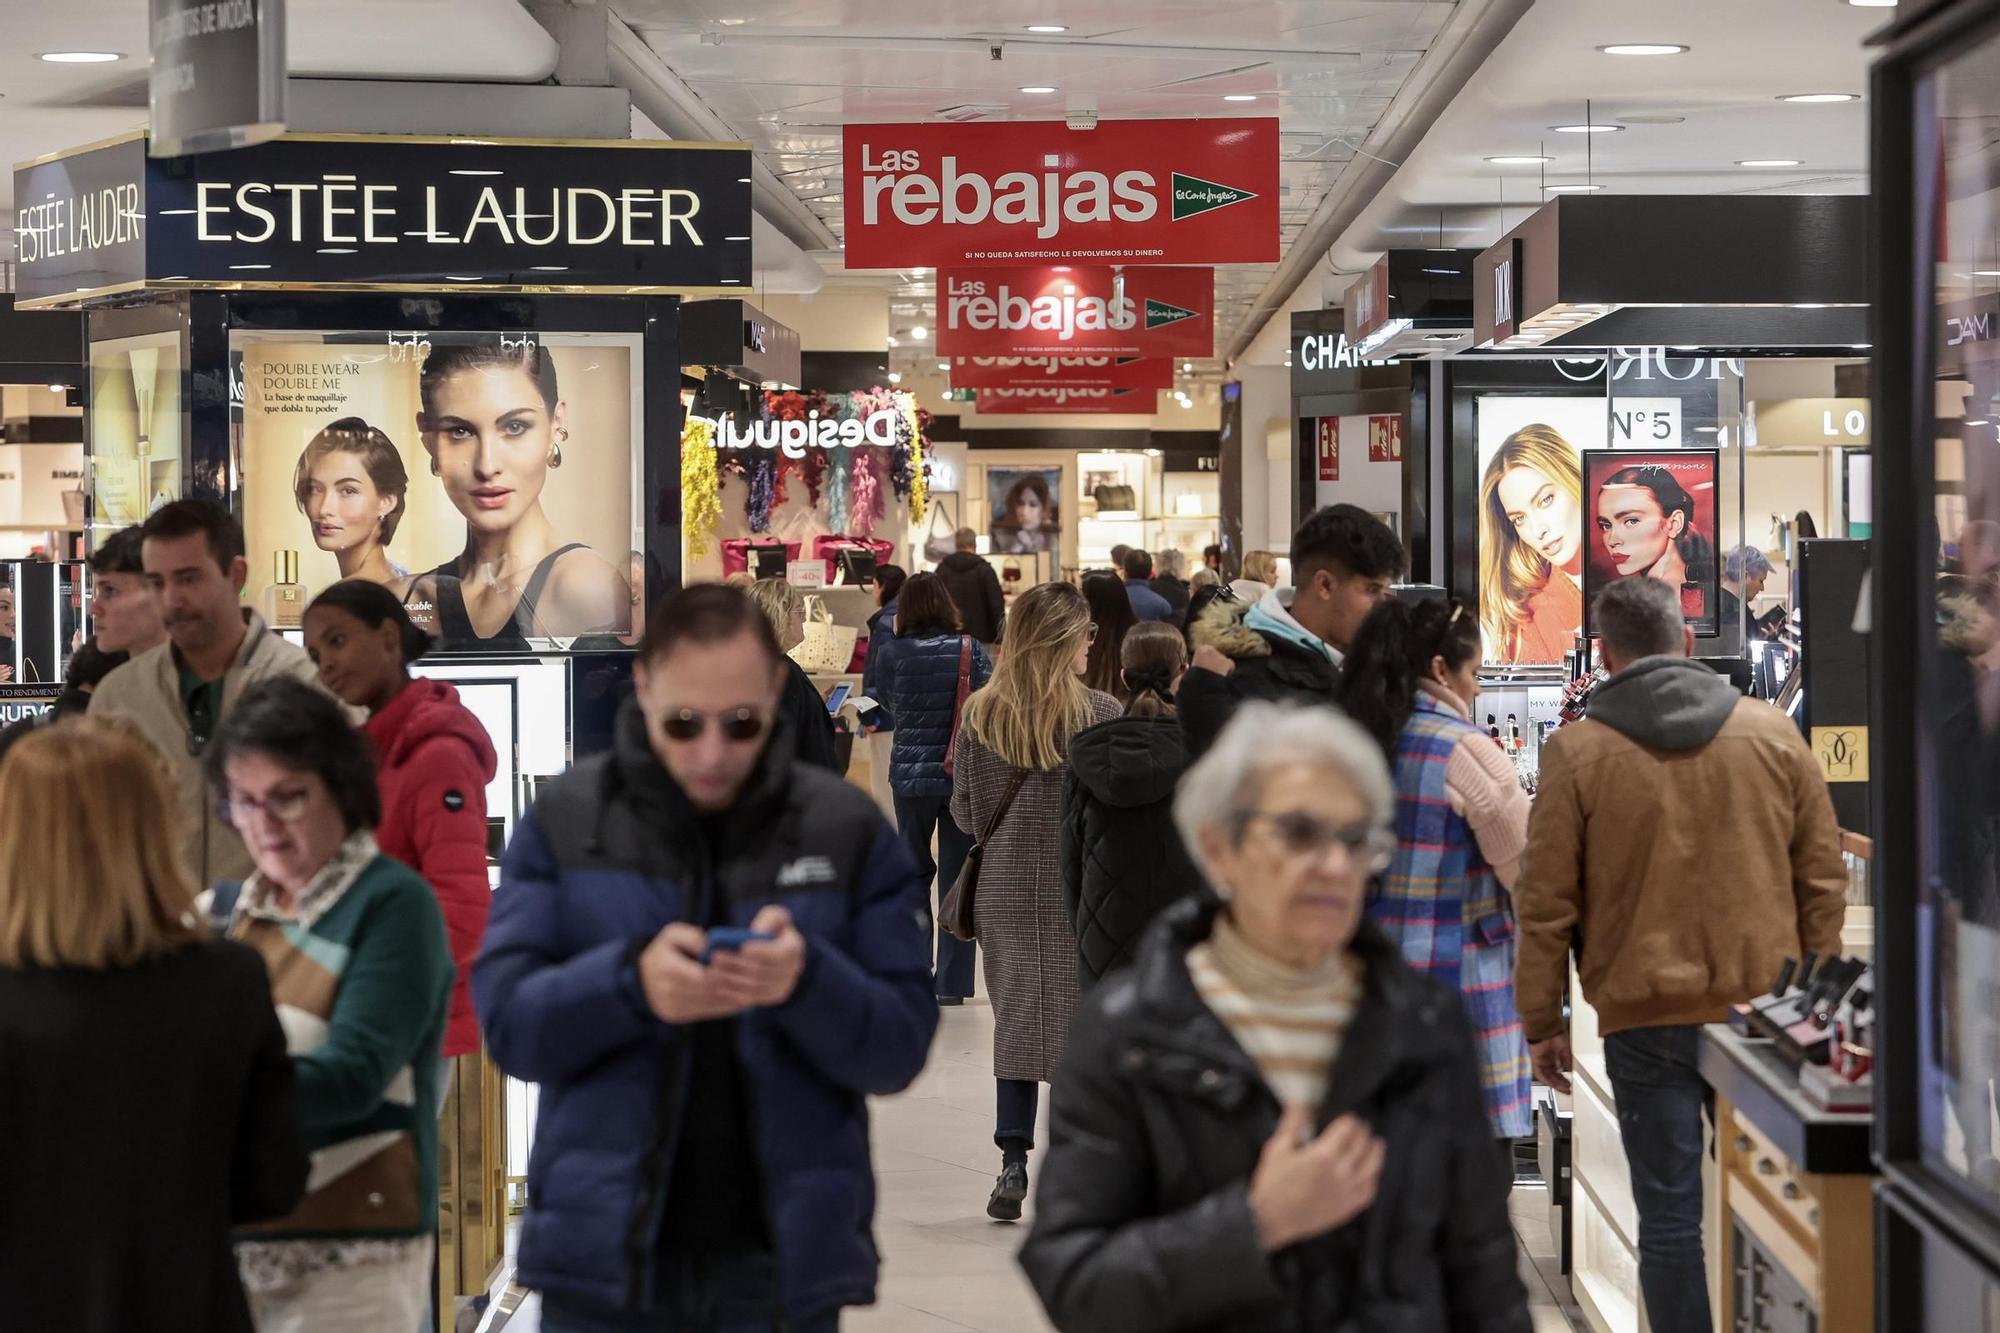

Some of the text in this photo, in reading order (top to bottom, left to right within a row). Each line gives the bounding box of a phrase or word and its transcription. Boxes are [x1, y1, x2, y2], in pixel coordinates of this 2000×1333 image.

[862, 143, 920, 172] Las
[863, 154, 1158, 239] rebajas
[70, 183, 139, 253] LAUDER
[426, 186, 704, 246] LAUDER
[948, 276, 986, 295] Las
[948, 285, 1136, 340] rebajas
[263, 363, 360, 375] DOUBLE WEAR
[263, 377, 341, 389] DOUBLE ME
[264, 393, 347, 403] La base de maquillaje
[264, 404, 338, 414] que dobla tu poder
[1530, 700, 1545, 708] MY
